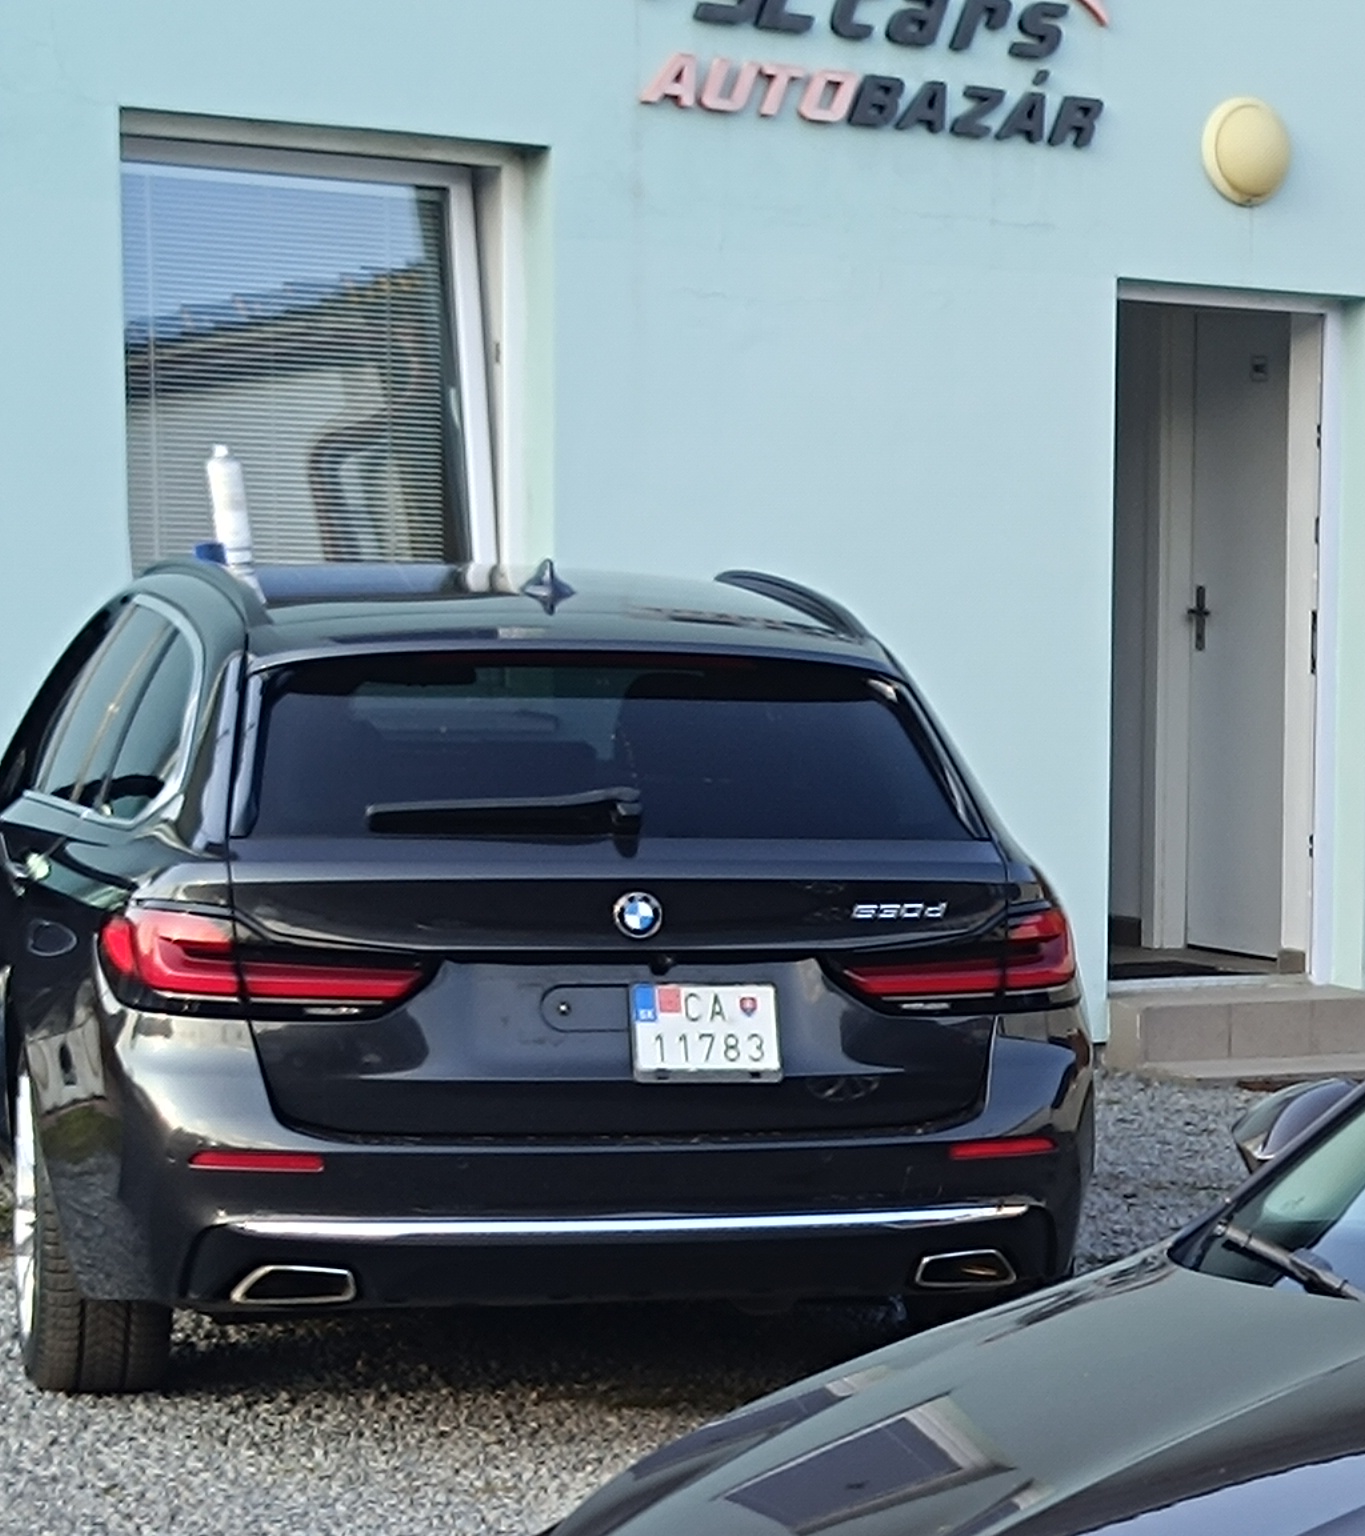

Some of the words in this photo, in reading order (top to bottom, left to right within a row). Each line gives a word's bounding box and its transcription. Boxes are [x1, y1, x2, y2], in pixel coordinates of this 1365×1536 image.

[638, 52, 1105, 149] AUTOBAZÁR
[684, 993, 726, 1022] CA
[655, 1033, 765, 1062] 11783
